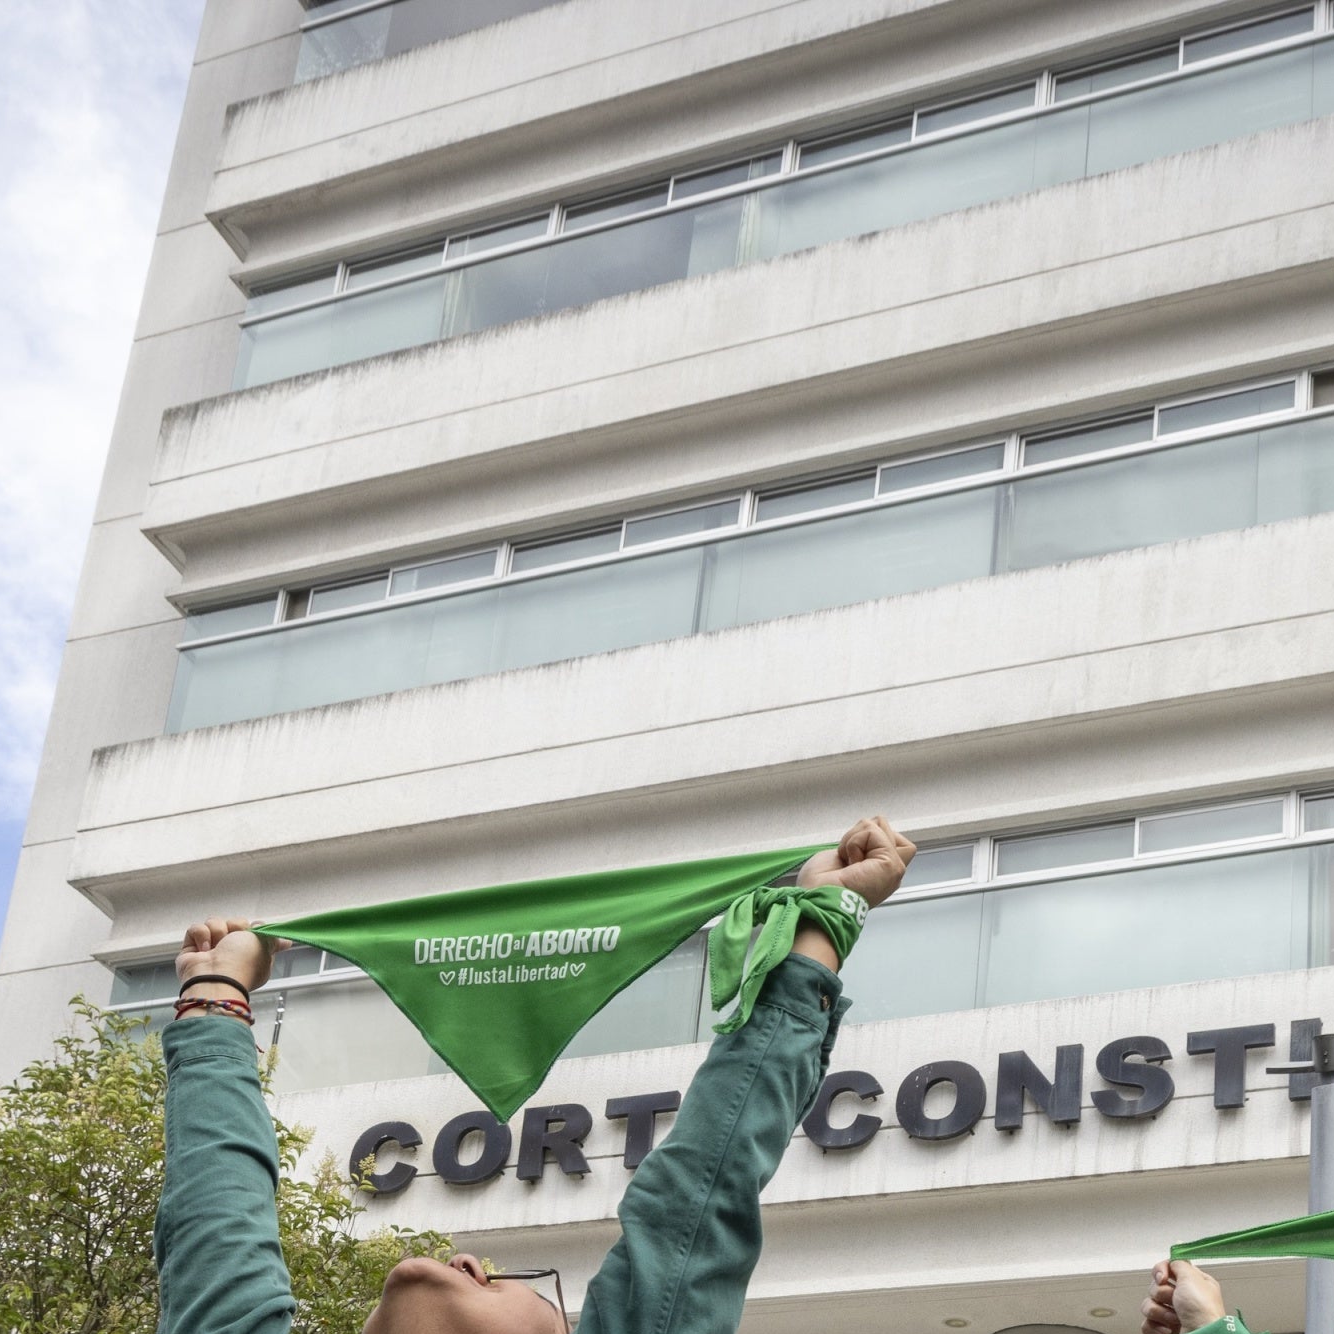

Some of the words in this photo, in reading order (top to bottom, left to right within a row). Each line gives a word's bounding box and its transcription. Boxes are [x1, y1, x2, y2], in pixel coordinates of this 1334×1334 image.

[414, 933, 513, 964] DERECHO
[513, 935, 525, 950] al
[525, 926, 621, 957] ABORTO
[458, 962, 568, 986] #JustaLibertad
[349, 1090, 681, 1194] CORT
